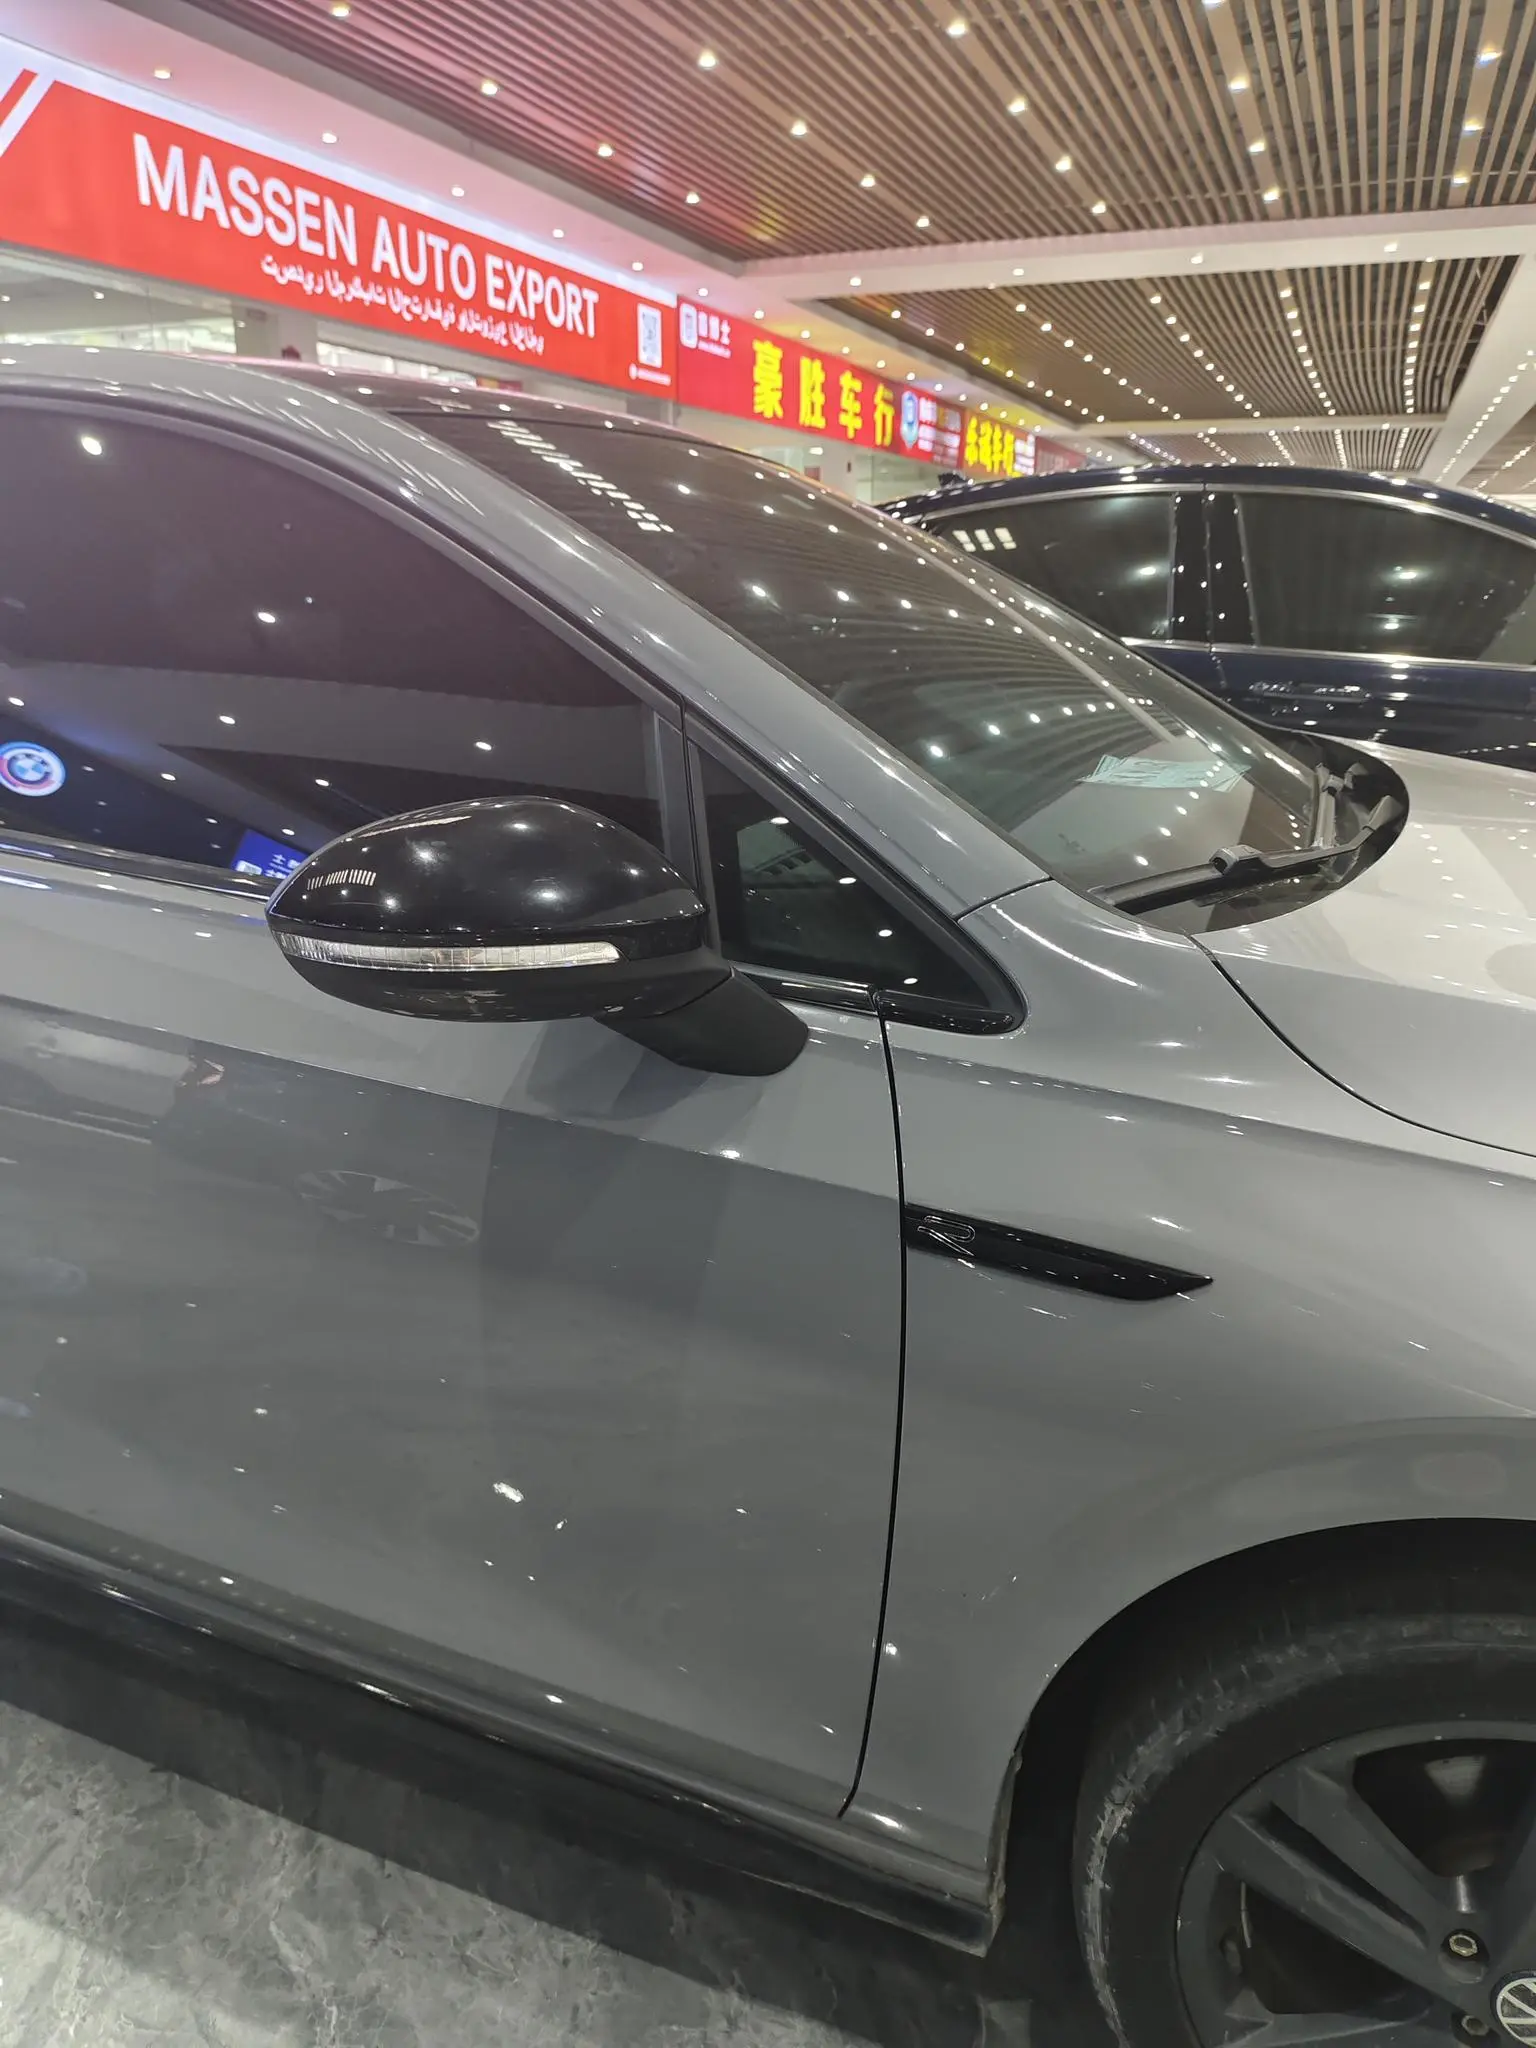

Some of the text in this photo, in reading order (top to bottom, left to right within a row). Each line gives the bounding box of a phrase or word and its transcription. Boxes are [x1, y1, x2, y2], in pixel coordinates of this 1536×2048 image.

[133, 133, 357, 265] MASSEN
[371, 216, 476, 300] AUTO
[486, 254, 599, 337] EXPORT
[752, 338, 895, 447] 豪胜车行
